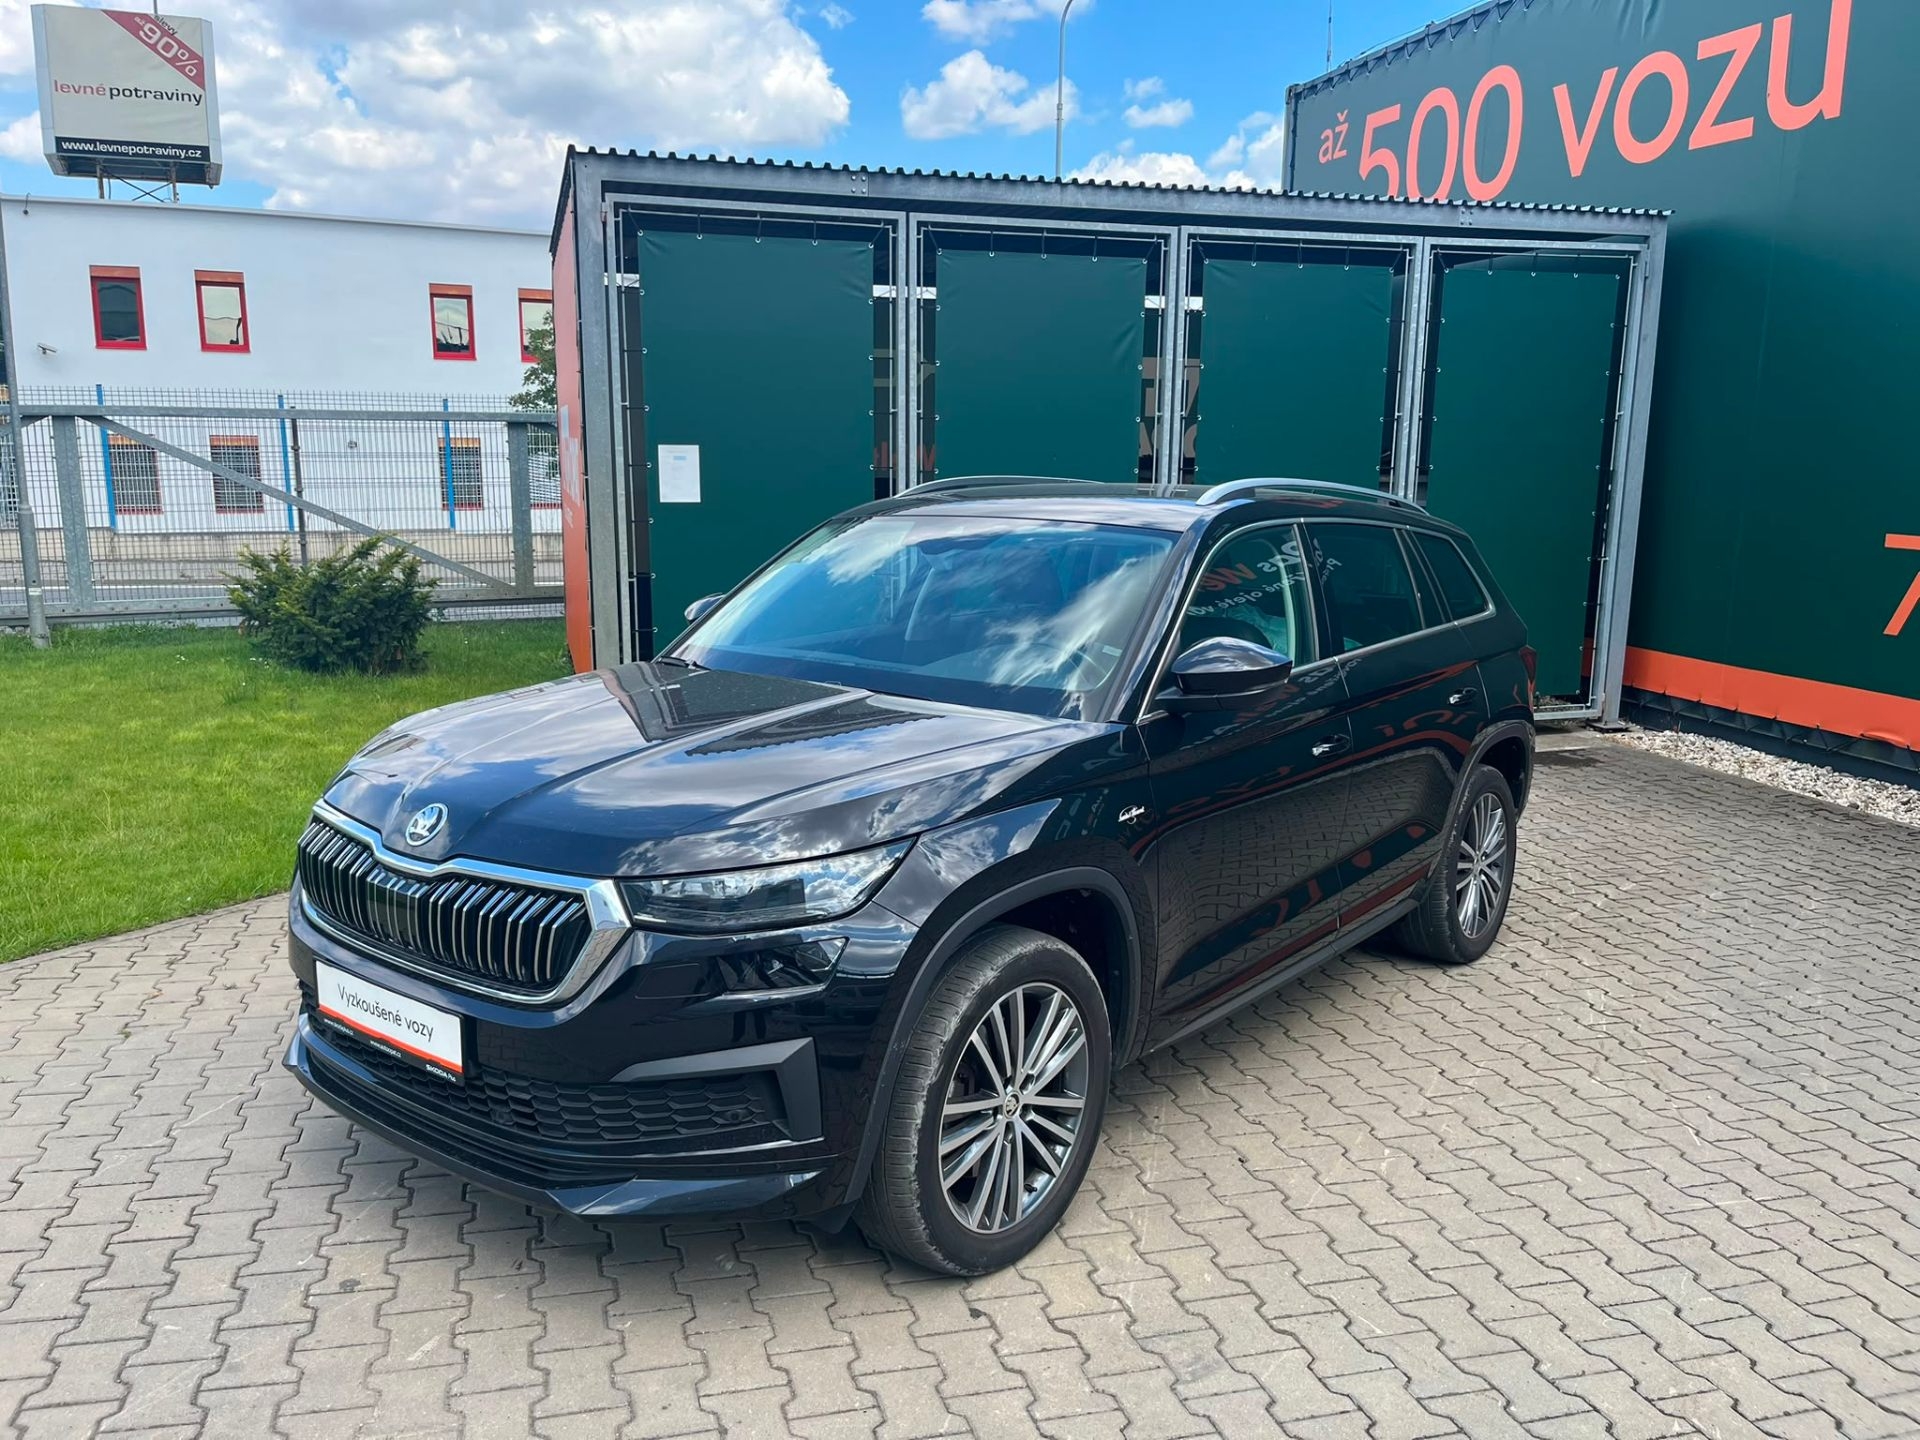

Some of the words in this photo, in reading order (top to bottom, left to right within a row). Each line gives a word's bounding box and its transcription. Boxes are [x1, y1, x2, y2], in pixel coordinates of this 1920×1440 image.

[139, 23, 199, 76] 90%
[61, 141, 202, 159] www.levnepotraviny.cz
[1318, 109, 1350, 164] až
[1359, 65, 1523, 202] 500
[338, 984, 402, 1026] Vyzkoušené
[405, 1016, 434, 1042] vozy
